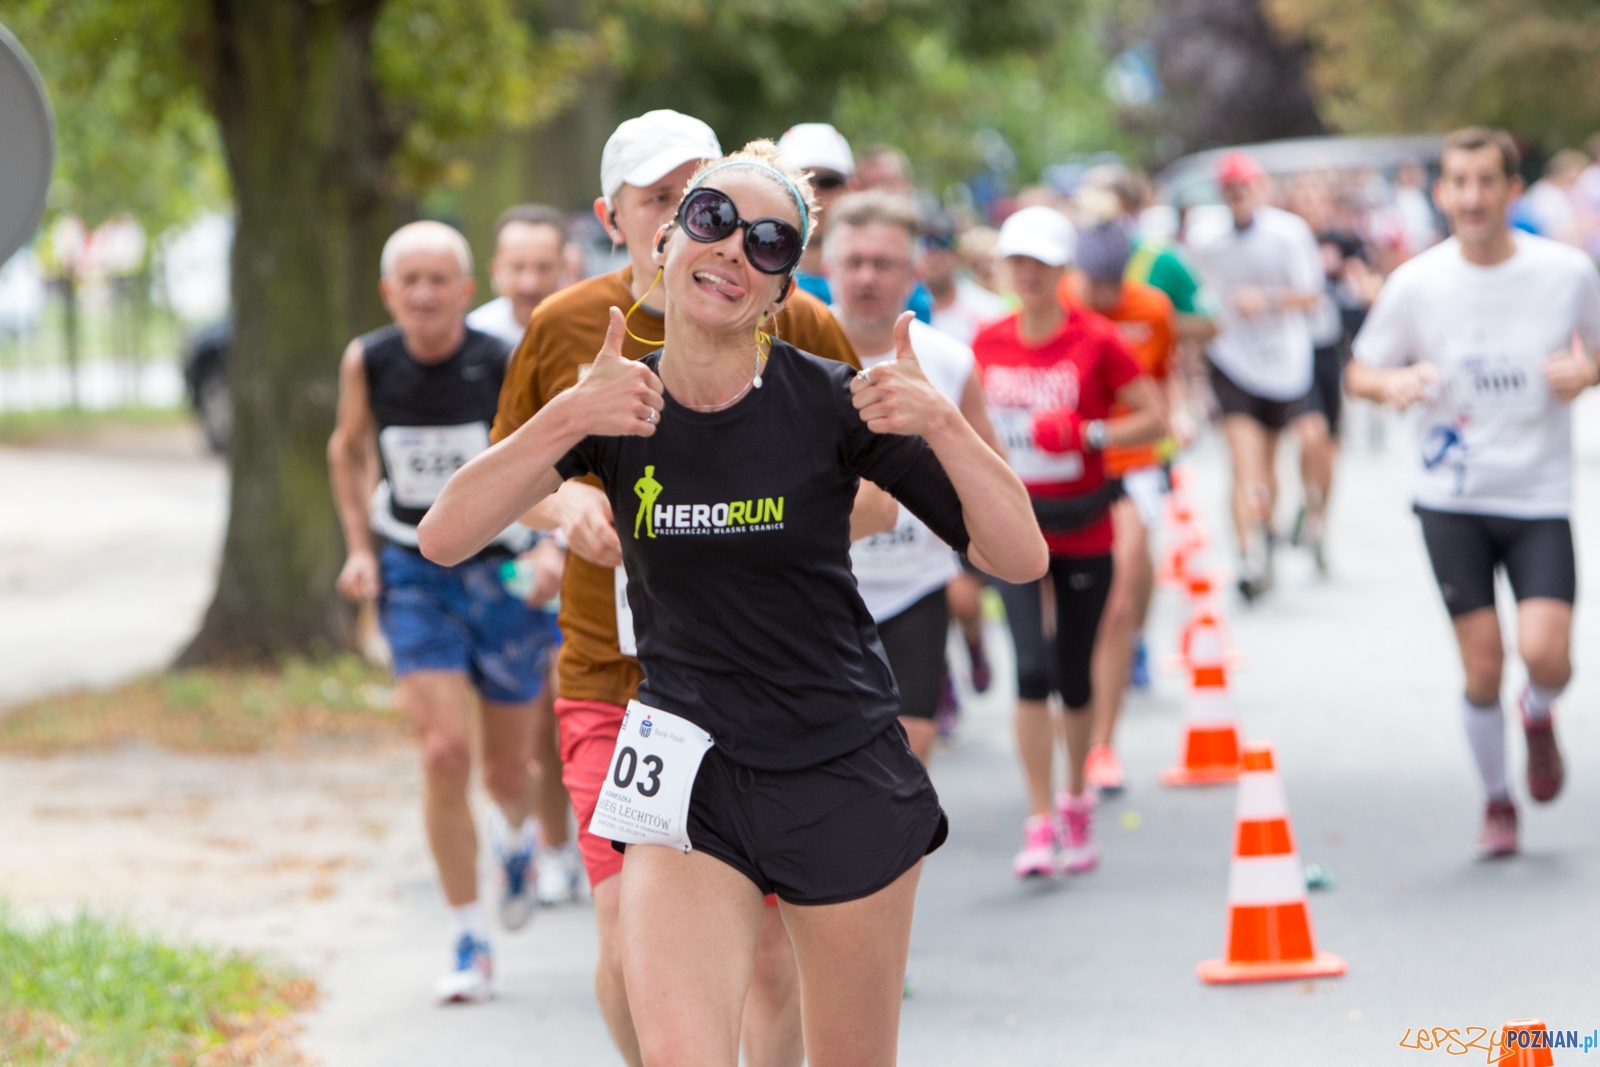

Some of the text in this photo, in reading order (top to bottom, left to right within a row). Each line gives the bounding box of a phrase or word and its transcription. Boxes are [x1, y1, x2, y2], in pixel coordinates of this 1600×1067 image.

[654, 497, 784, 527] HERORUN
[713, 526, 746, 534] WŁASNE
[749, 523, 784, 532] GRANICE
[655, 728, 667, 739] Bank
[669, 733, 685, 744] Polski
[613, 746, 664, 798] 03
[605, 790, 632, 804] AGNIESZKA
[618, 804, 671, 830] LECHITÓW
